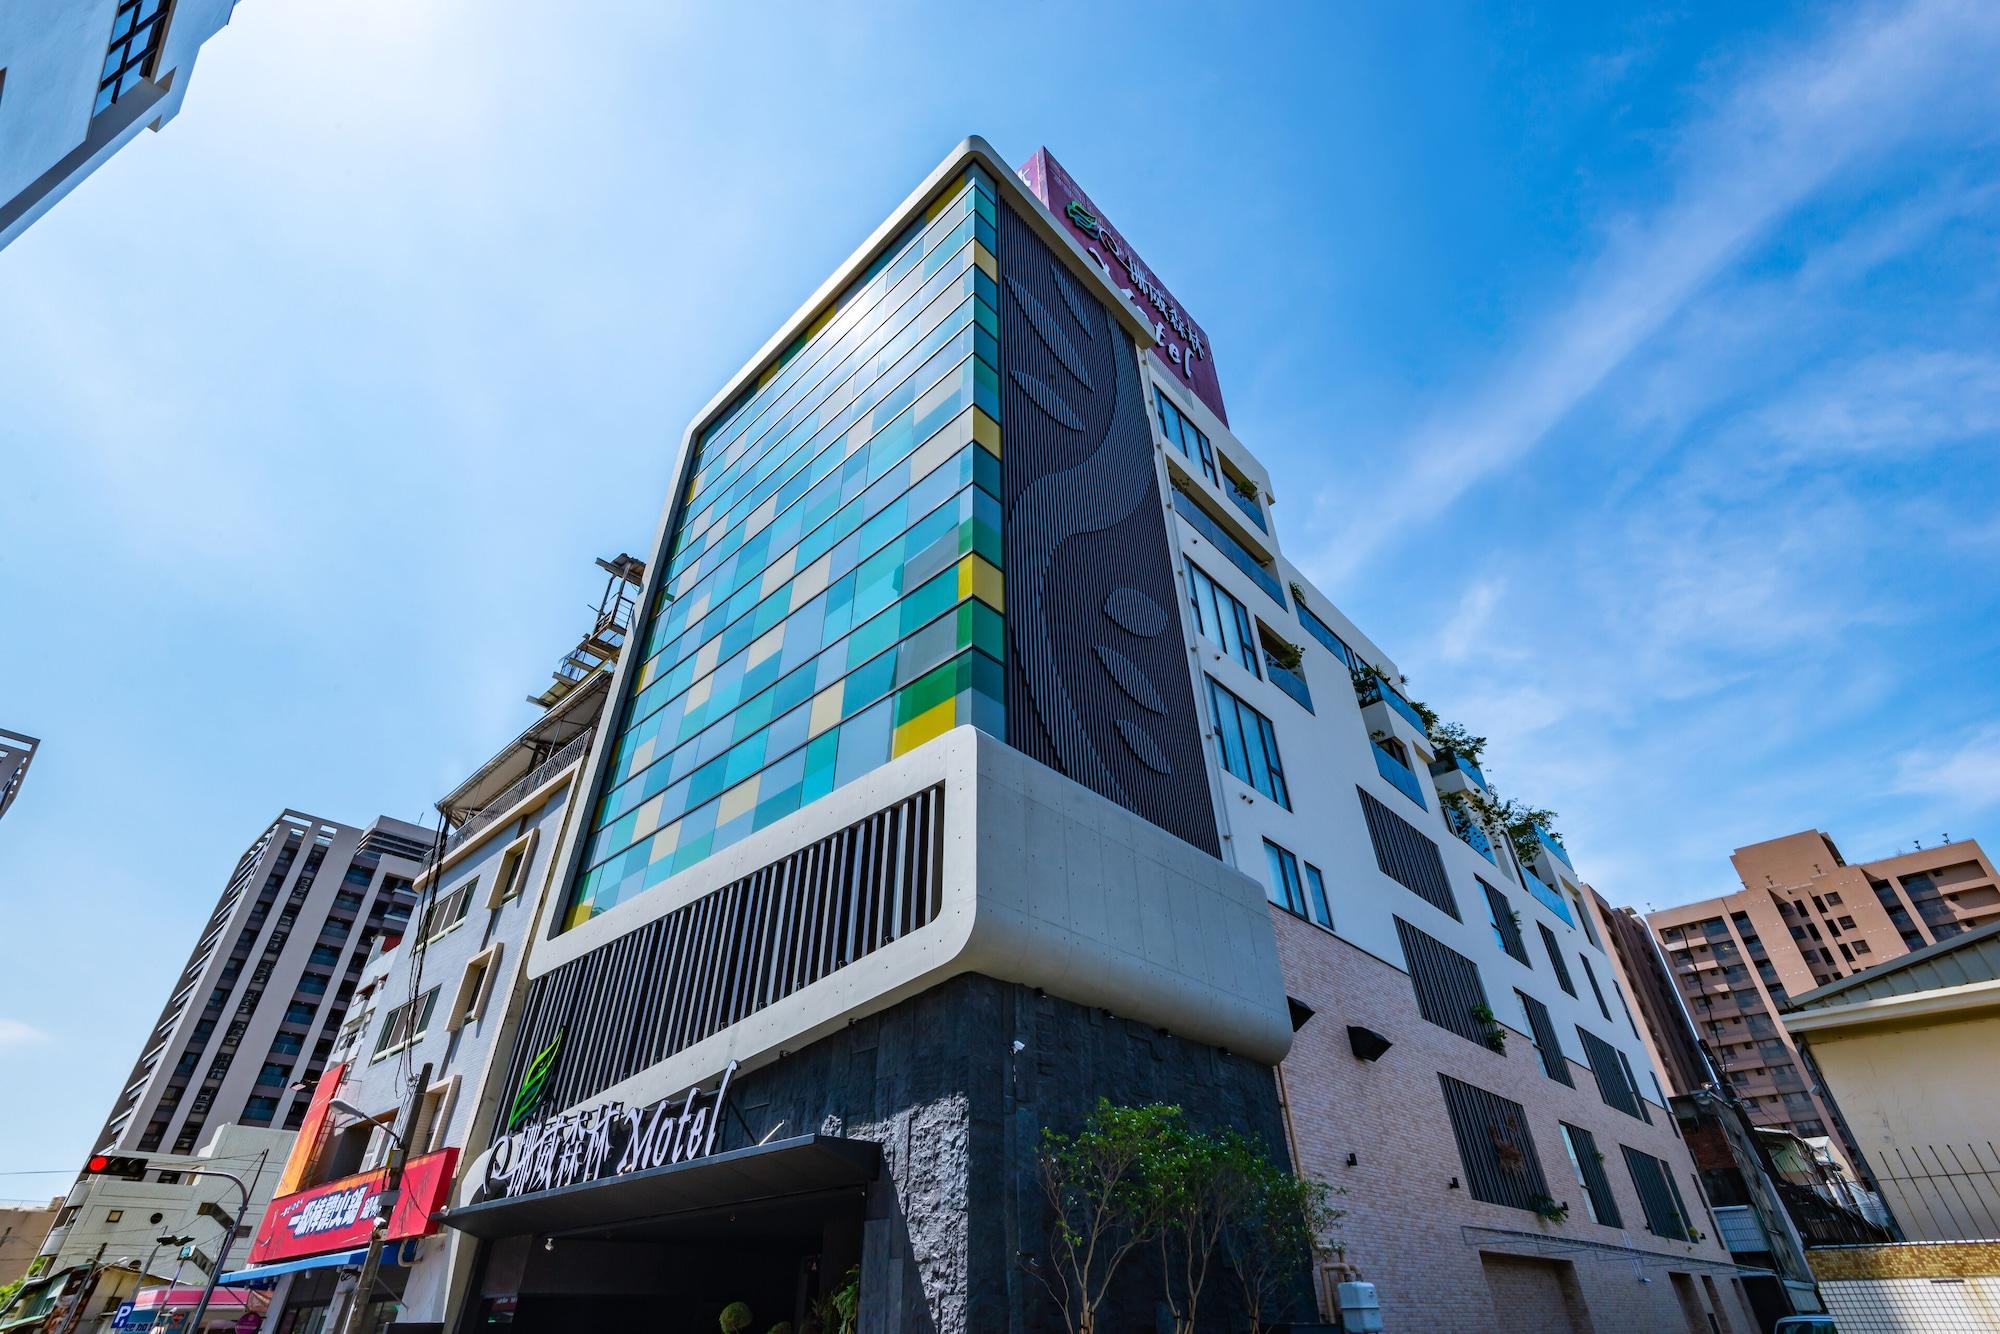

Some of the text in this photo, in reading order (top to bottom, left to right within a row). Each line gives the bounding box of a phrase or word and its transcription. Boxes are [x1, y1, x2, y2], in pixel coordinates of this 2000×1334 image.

[486, 1060, 738, 1198] 挪威森林 Motel
[115, 1305, 131, 1323] P
